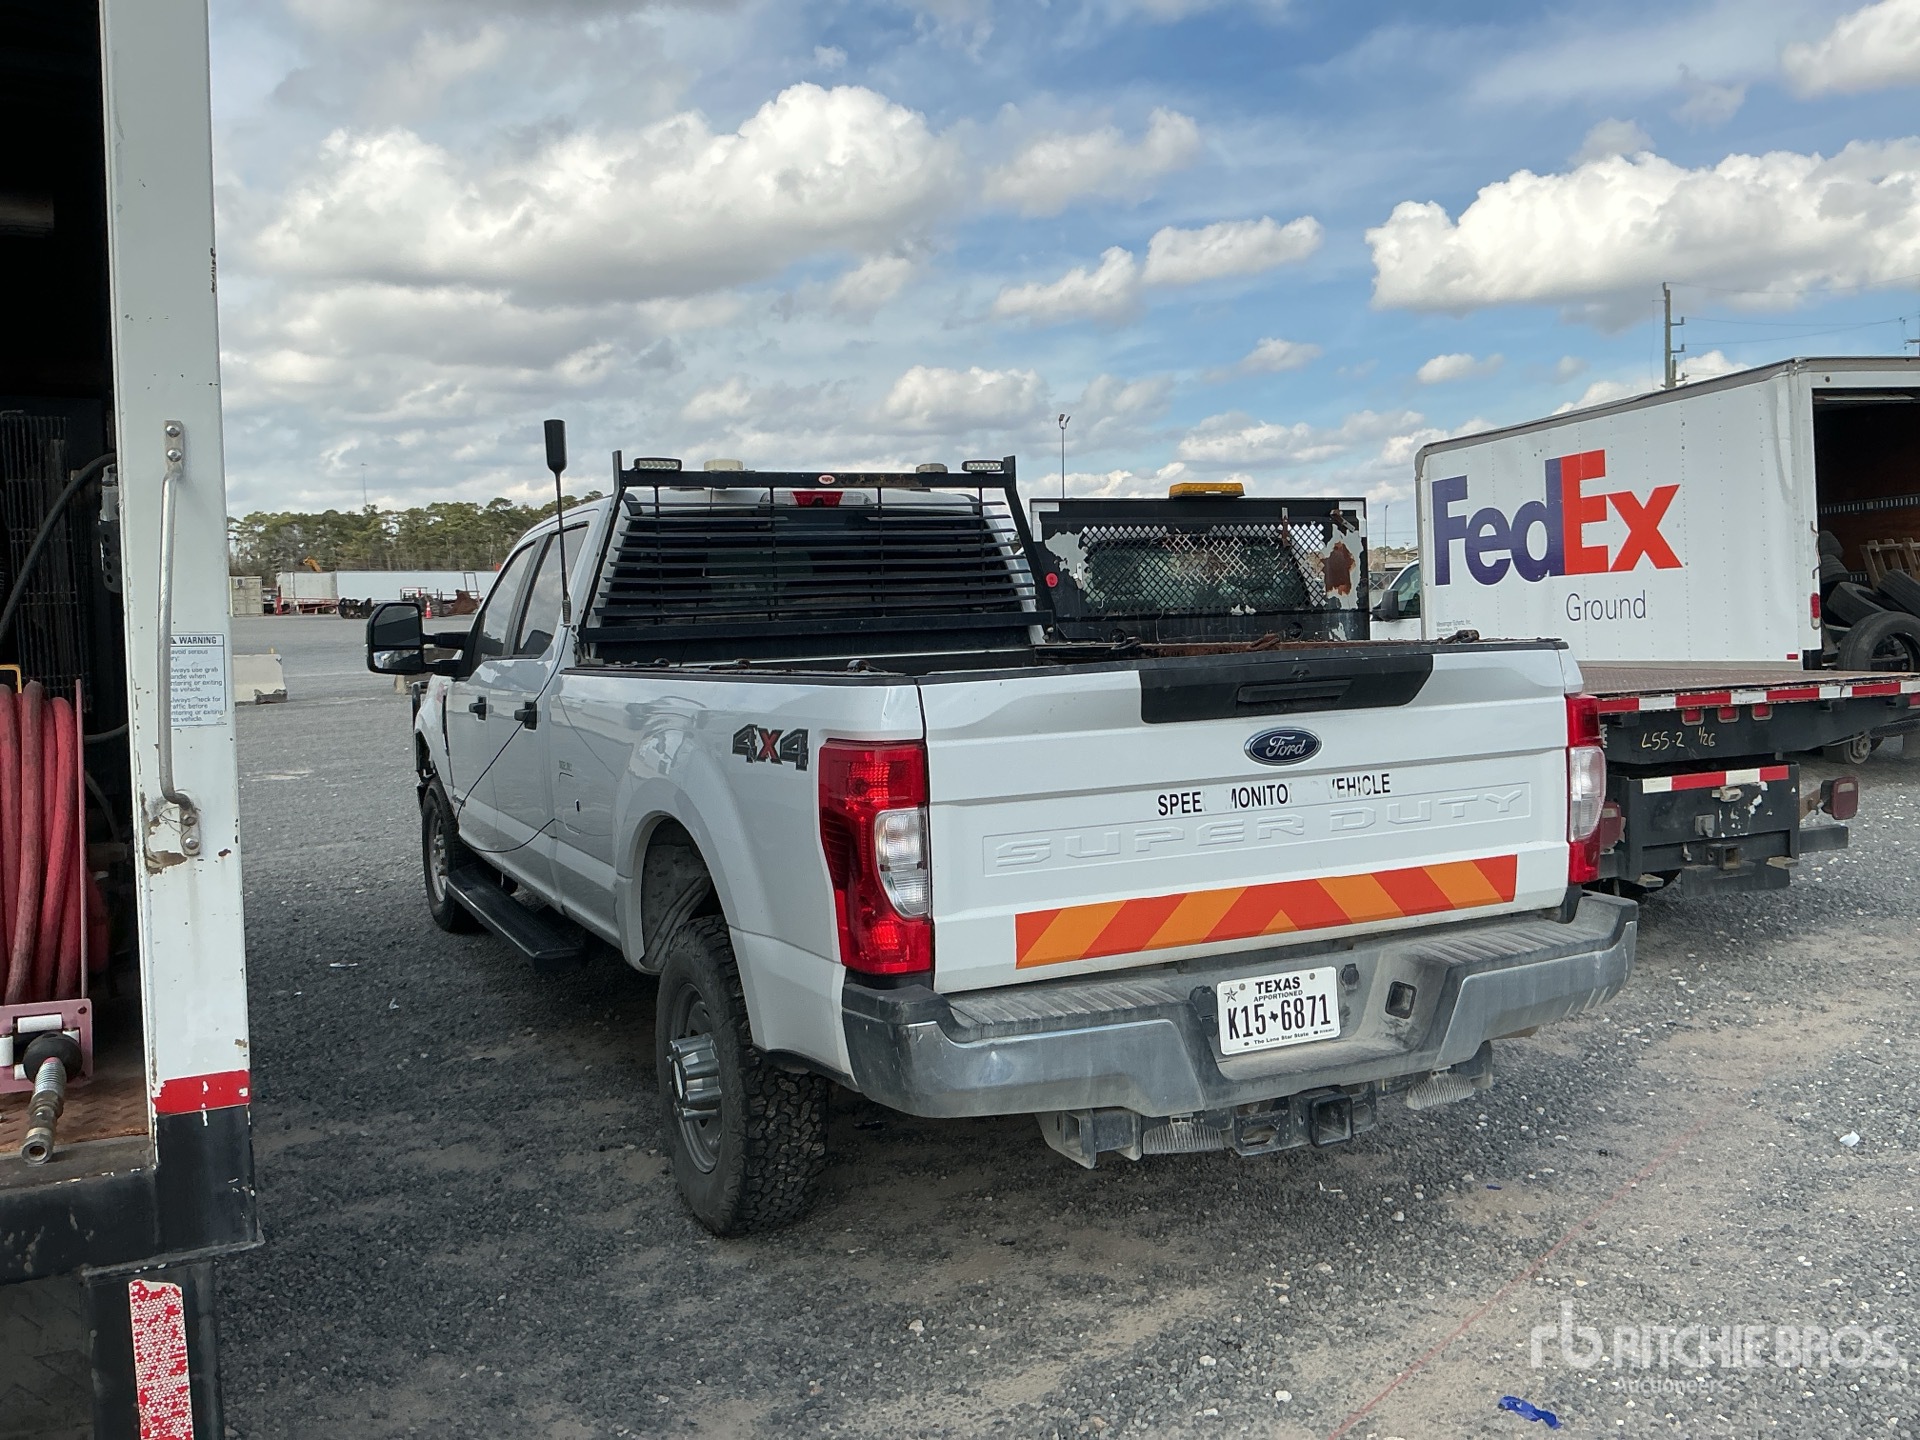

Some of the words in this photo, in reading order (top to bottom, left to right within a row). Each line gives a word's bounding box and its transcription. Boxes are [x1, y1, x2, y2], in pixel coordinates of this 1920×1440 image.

[1432, 449, 1683, 586] FedEx
[1566, 590, 1646, 622] Ground
[179, 636, 217, 644] WARNING
[1265, 735, 1306, 757] Ford
[995, 814, 1304, 867] SUPER
[1330, 789, 1522, 831] DUTY
[1253, 990, 1303, 1003] APPORTIONED
[1255, 976, 1301, 995] TEXAS
[1227, 1003, 1267, 1040] K15
[1281, 993, 1331, 1031] 6871
